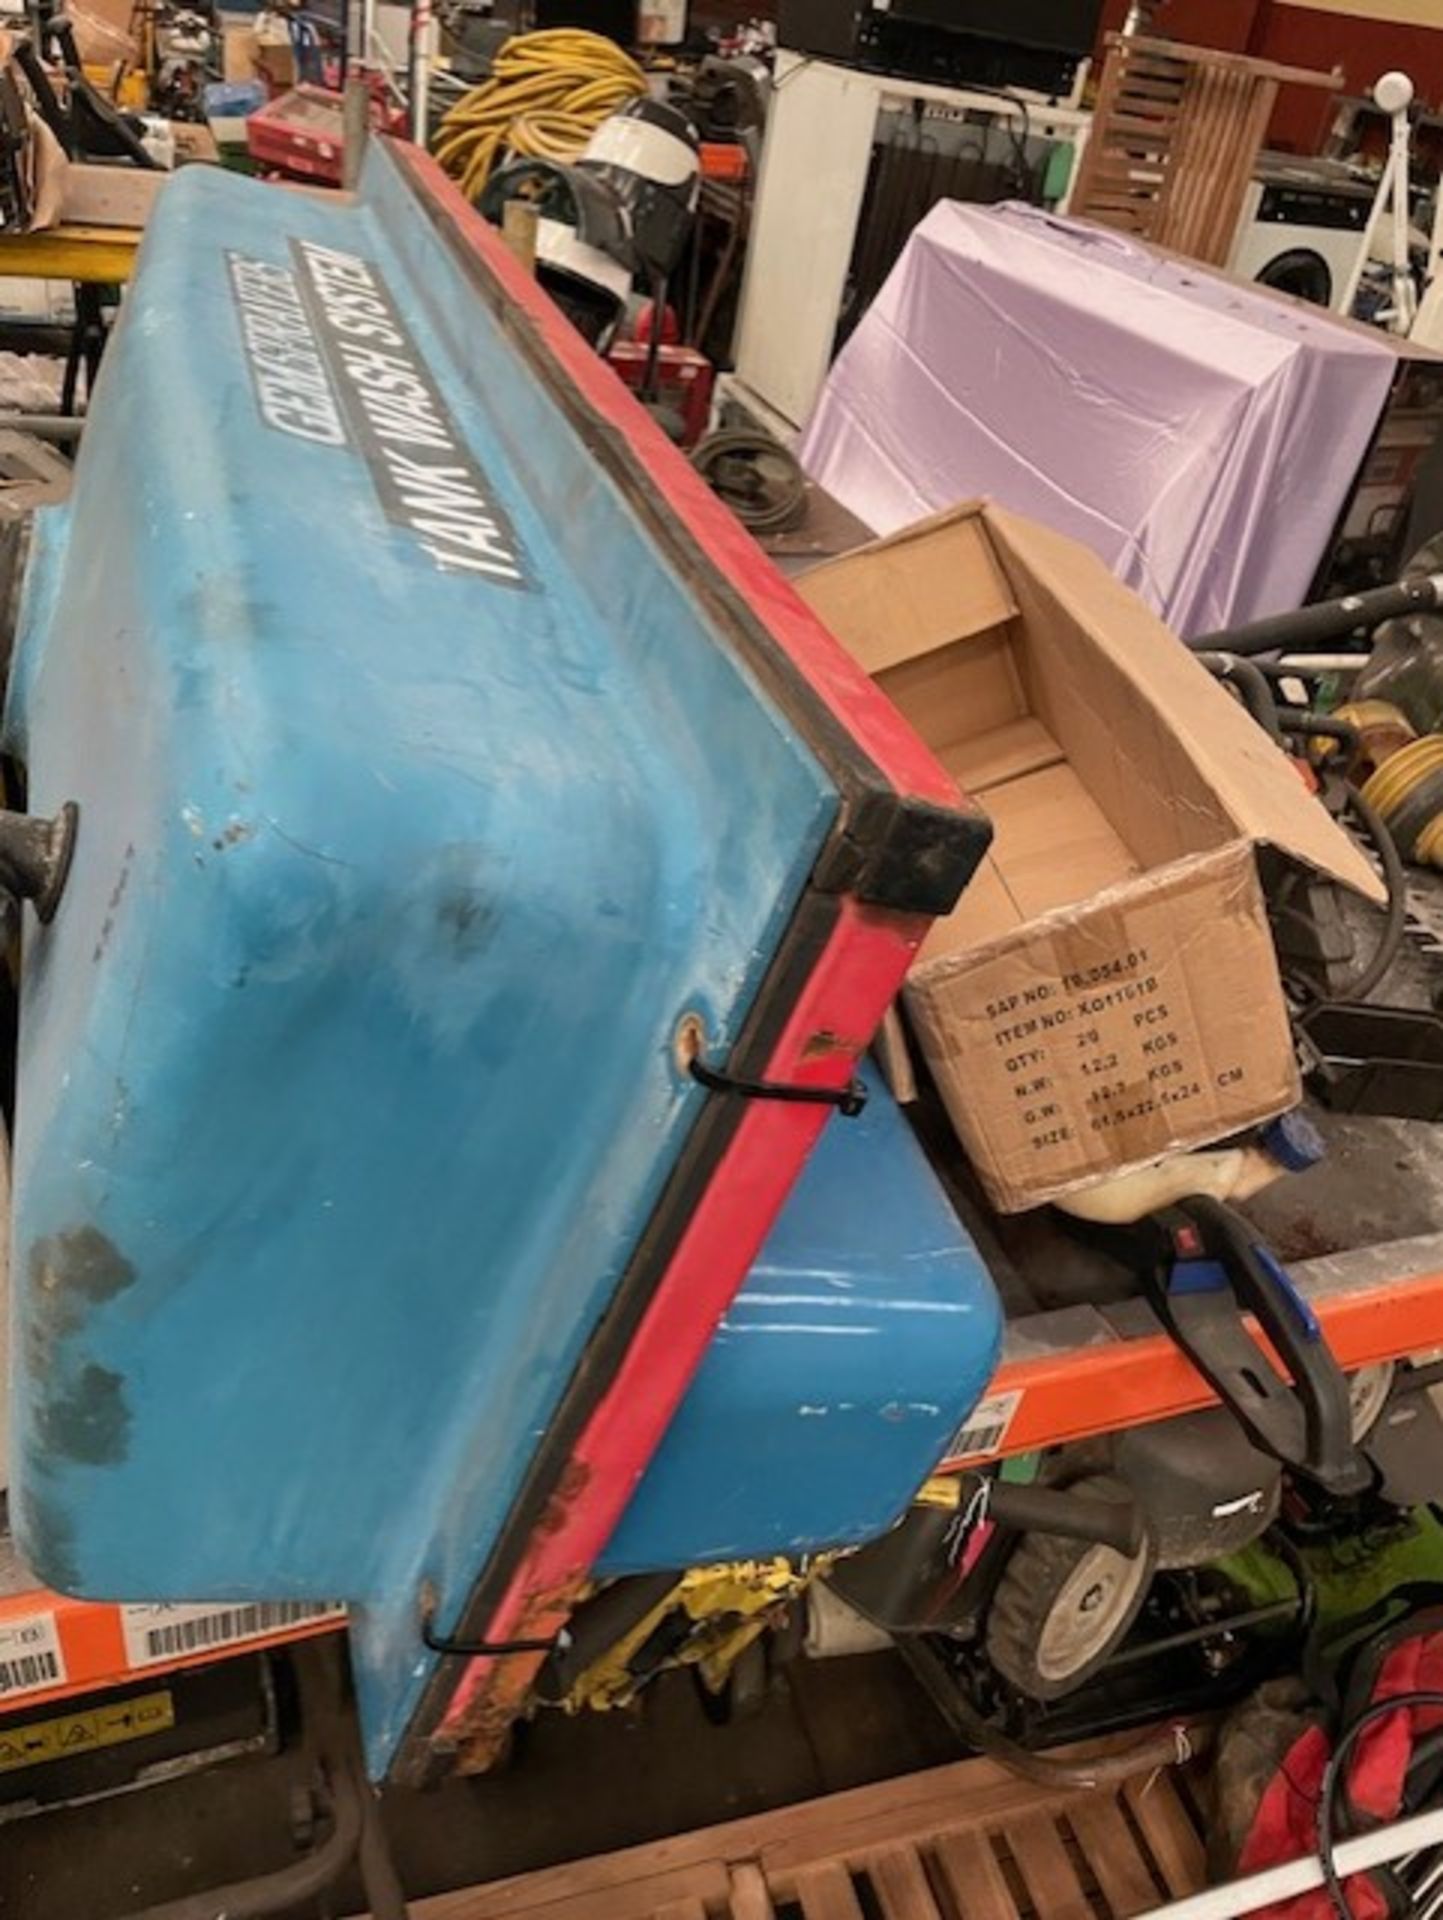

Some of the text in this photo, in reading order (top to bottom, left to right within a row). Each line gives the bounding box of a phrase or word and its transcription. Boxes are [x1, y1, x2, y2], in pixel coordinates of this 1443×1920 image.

[300, 238, 525, 581] TANK WASH SYSTEM
[986, 995, 1019, 1019] SAP
[1022, 984, 1057, 1005] NO:
[995, 1019, 1038, 1046] ITEM
[1040, 1009, 1074, 1030] NO:
[1005, 1050, 1046, 1073] QTY:
[1133, 1003, 1169, 1028] PCS
[1142, 1032, 1179, 1056] KGS
[1148, 1059, 1184, 1083] KGS
[1216, 1067, 1244, 1087] CM
